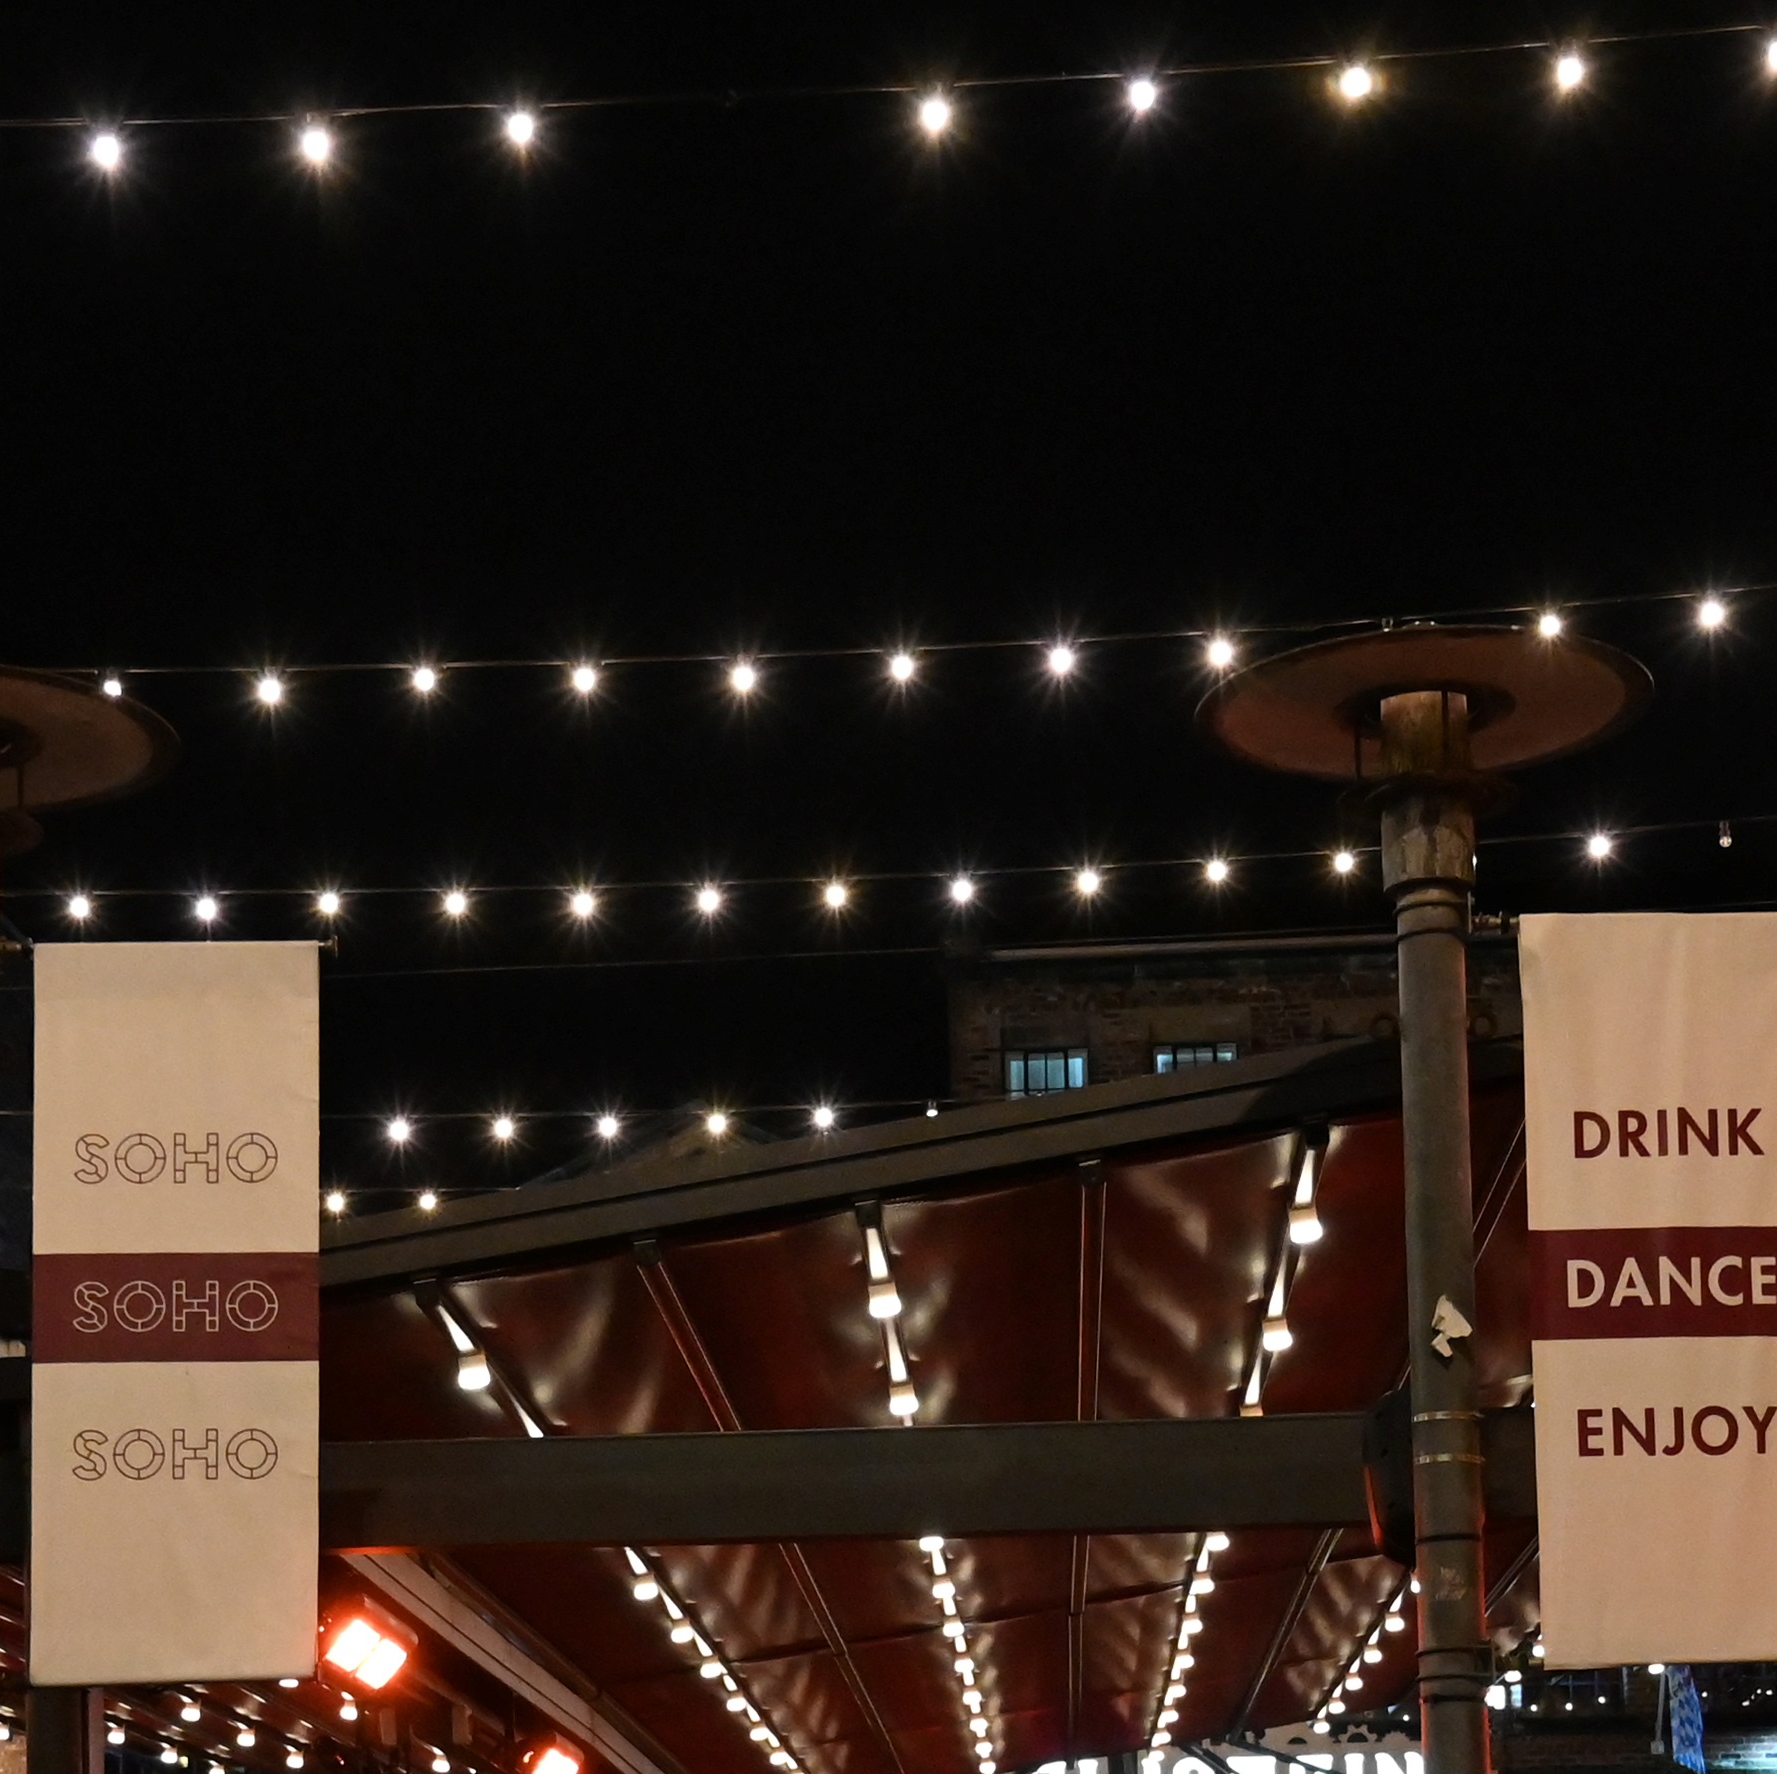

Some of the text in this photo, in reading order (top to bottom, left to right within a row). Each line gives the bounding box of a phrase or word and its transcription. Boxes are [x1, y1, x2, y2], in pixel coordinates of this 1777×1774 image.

[73, 1132, 278, 1184] SOHO
[1573, 1108, 1764, 1159] DRINK
[73, 1280, 278, 1332] SOHO
[1566, 1256, 1777, 1308] DANCE
[72, 1429, 278, 1481] SOHO
[1577, 1406, 1777, 1457] ENJOY
